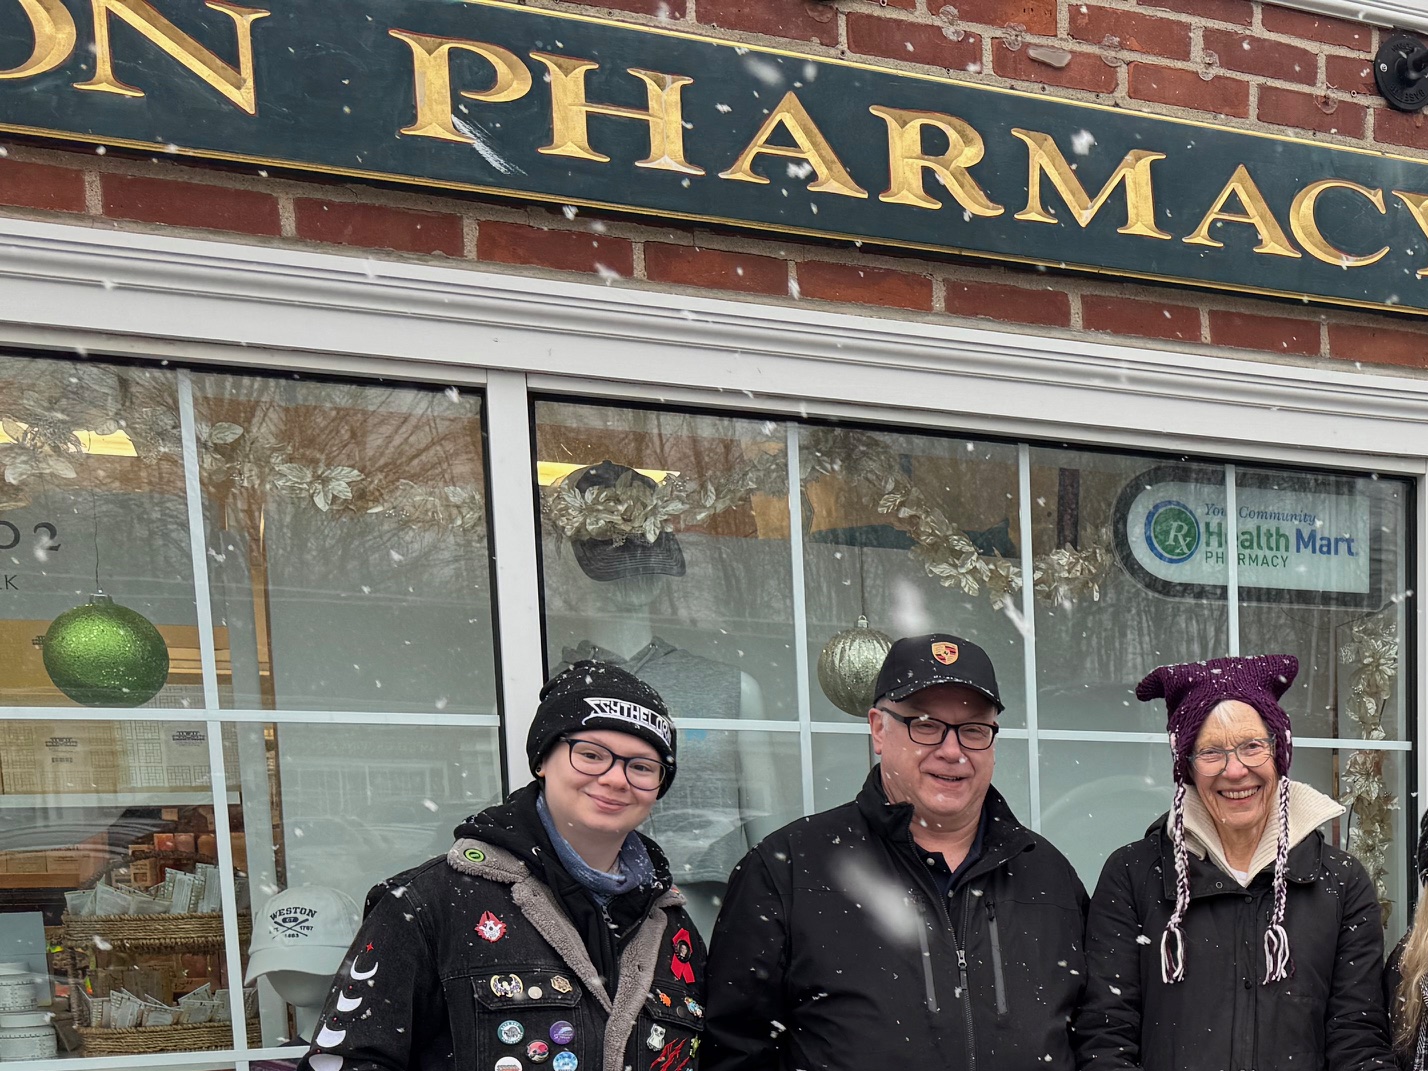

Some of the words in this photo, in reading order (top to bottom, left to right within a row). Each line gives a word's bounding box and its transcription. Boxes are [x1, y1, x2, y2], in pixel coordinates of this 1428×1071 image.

[1238, 505, 1317, 525] Community
[1204, 520, 1290, 553] Halth
[1295, 528, 1356, 557] Mart
[1205, 551, 1289, 568] PHRMACY
[269, 906, 318, 921] WESTON
